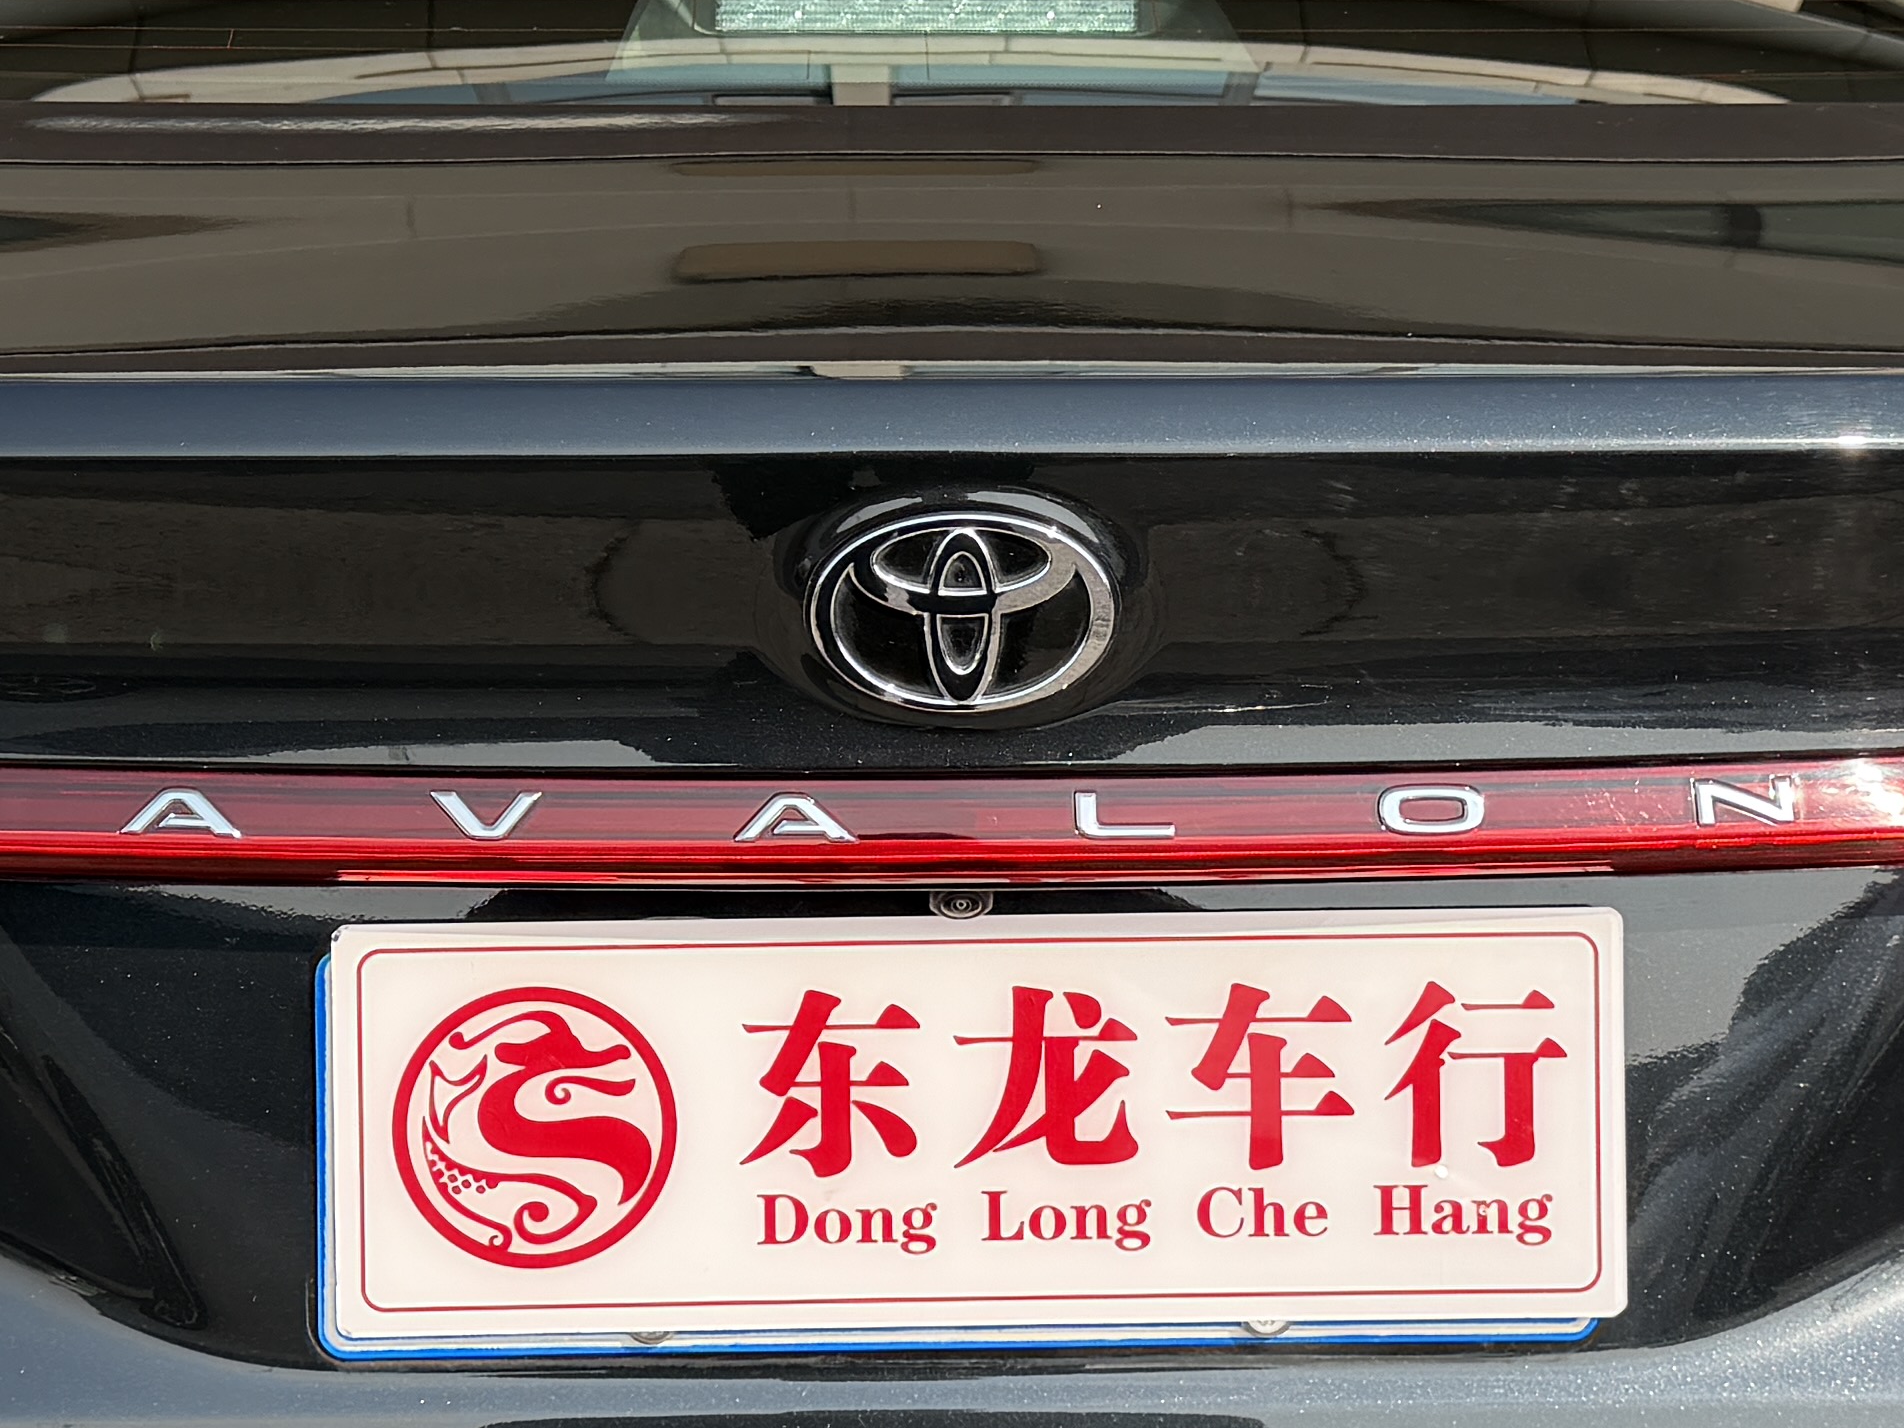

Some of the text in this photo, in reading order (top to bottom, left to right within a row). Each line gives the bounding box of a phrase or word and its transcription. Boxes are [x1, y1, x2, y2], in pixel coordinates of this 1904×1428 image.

[117, 774, 1798, 842] AVALON
[741, 981, 1569, 1179] 东龙车行
[758, 1184, 1554, 1255] Dong Long Che Hang
